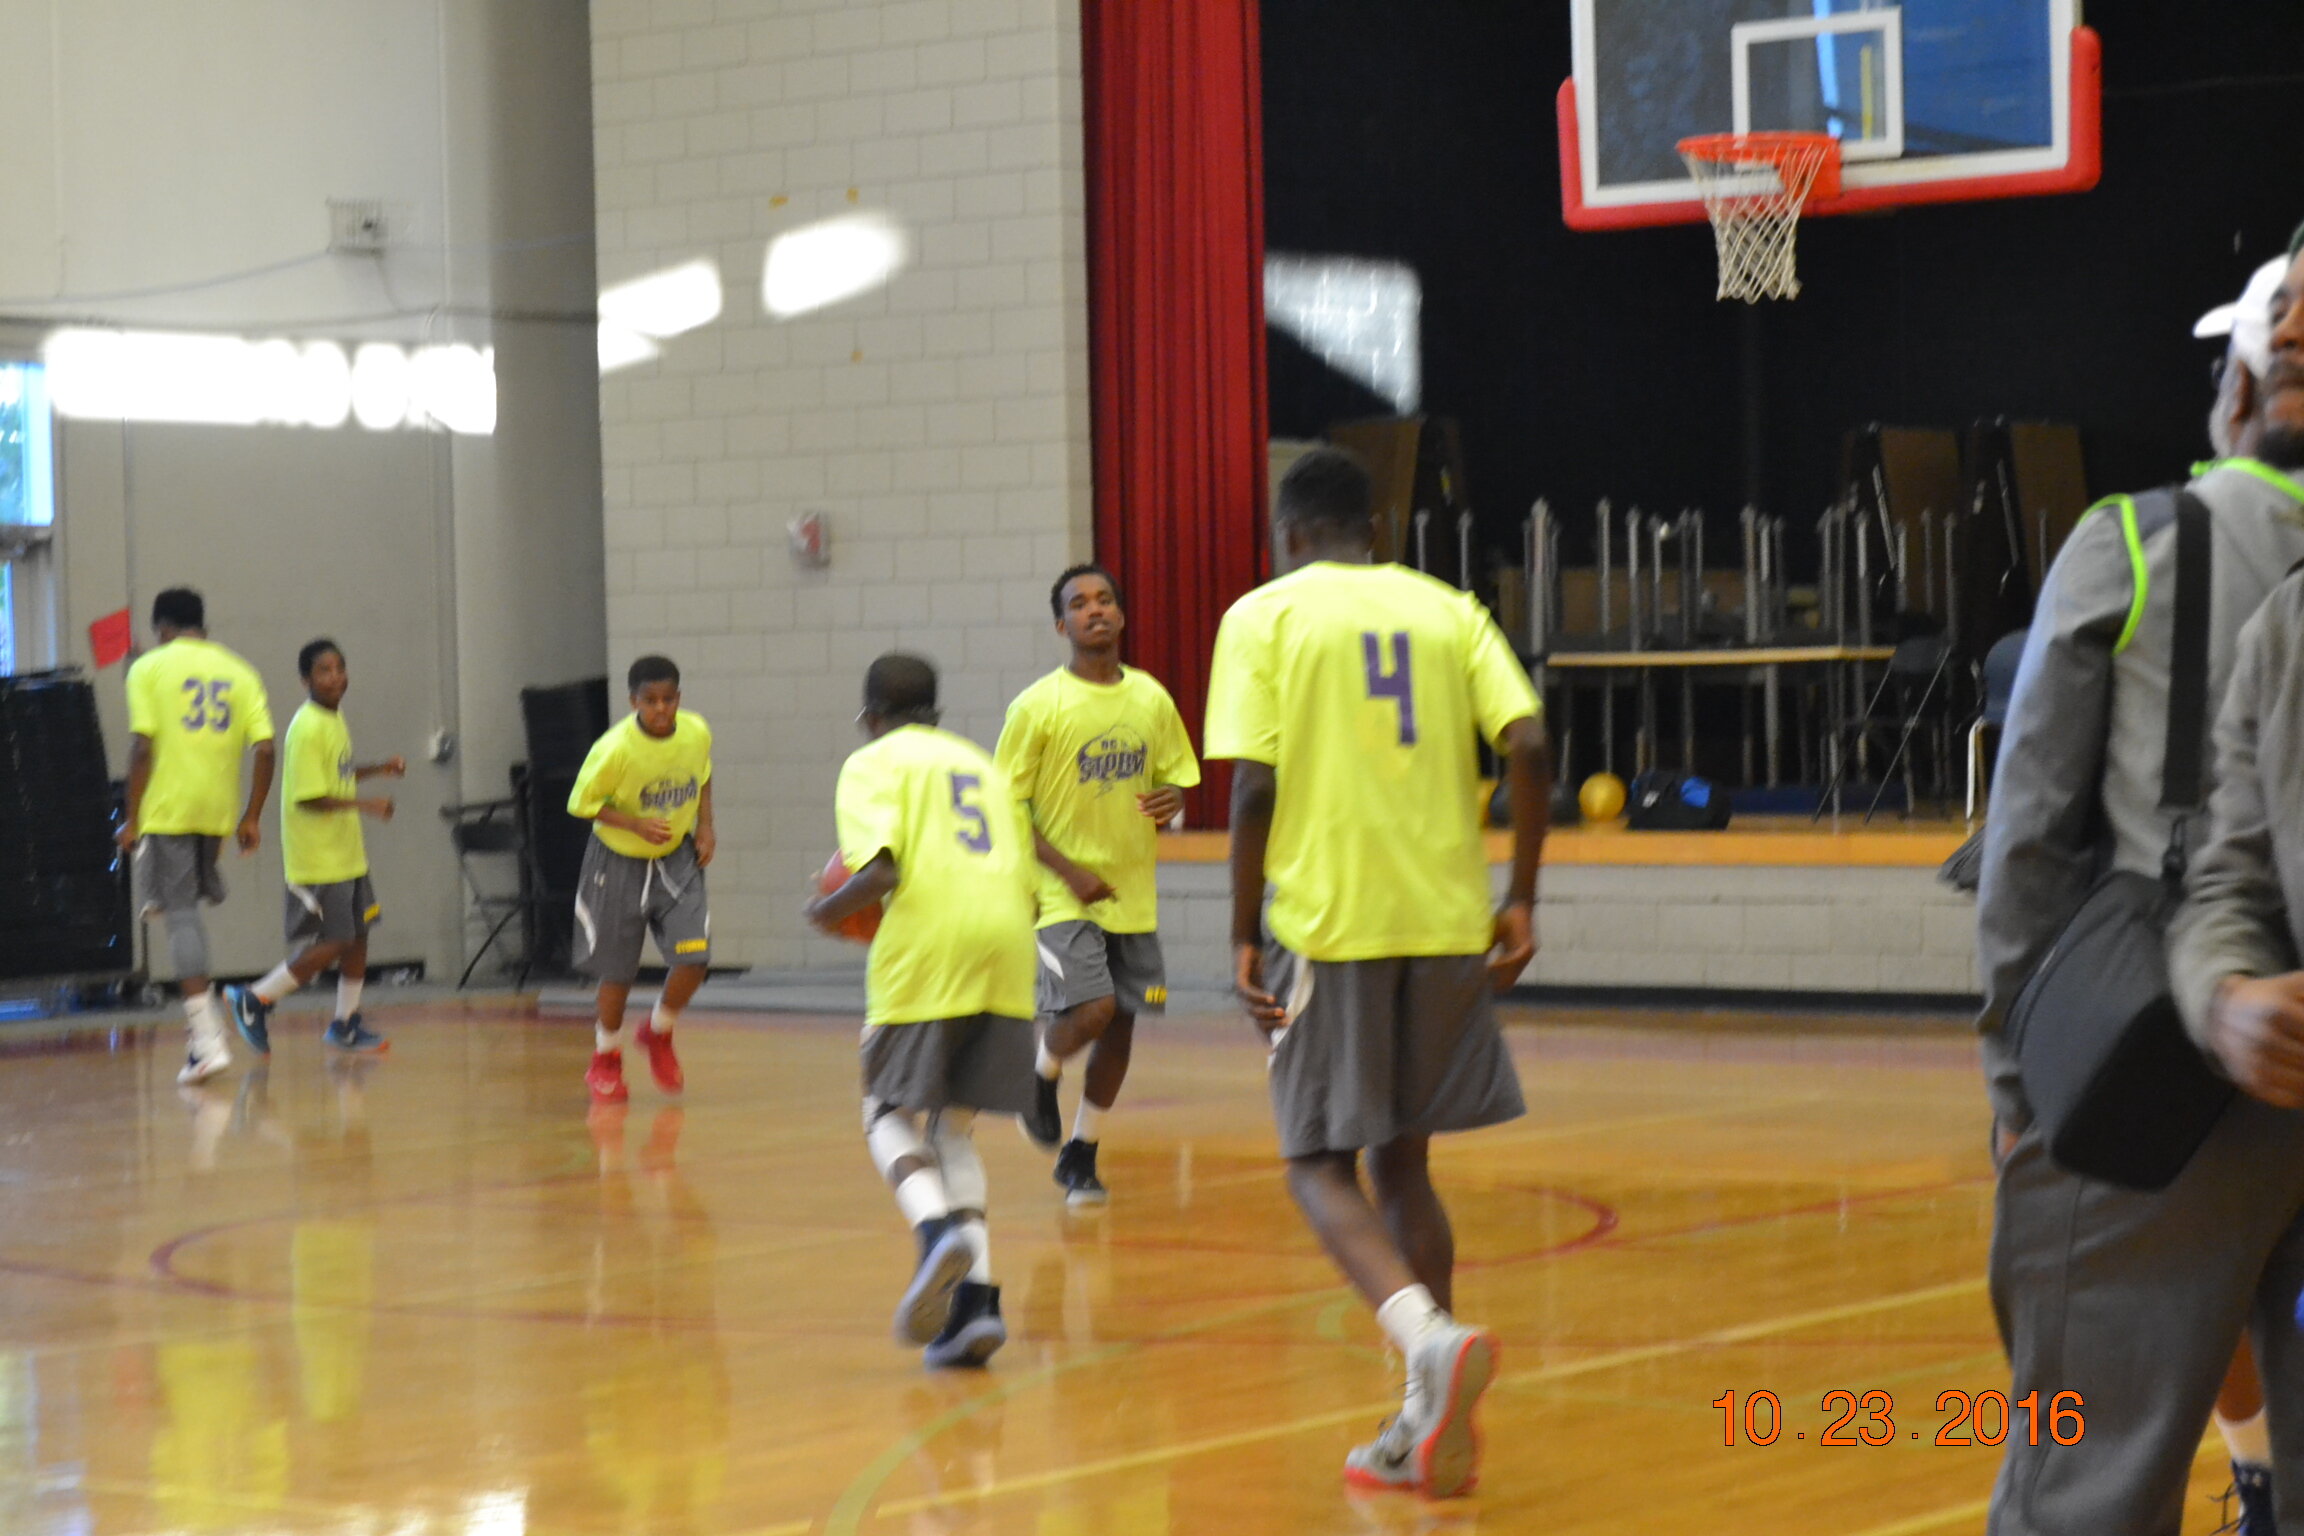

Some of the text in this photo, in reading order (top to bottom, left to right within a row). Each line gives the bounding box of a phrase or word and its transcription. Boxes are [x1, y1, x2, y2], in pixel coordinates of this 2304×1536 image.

[182, 676, 232, 732] 35
[1362, 631, 1416, 746] 4
[949, 773, 993, 854] 5
